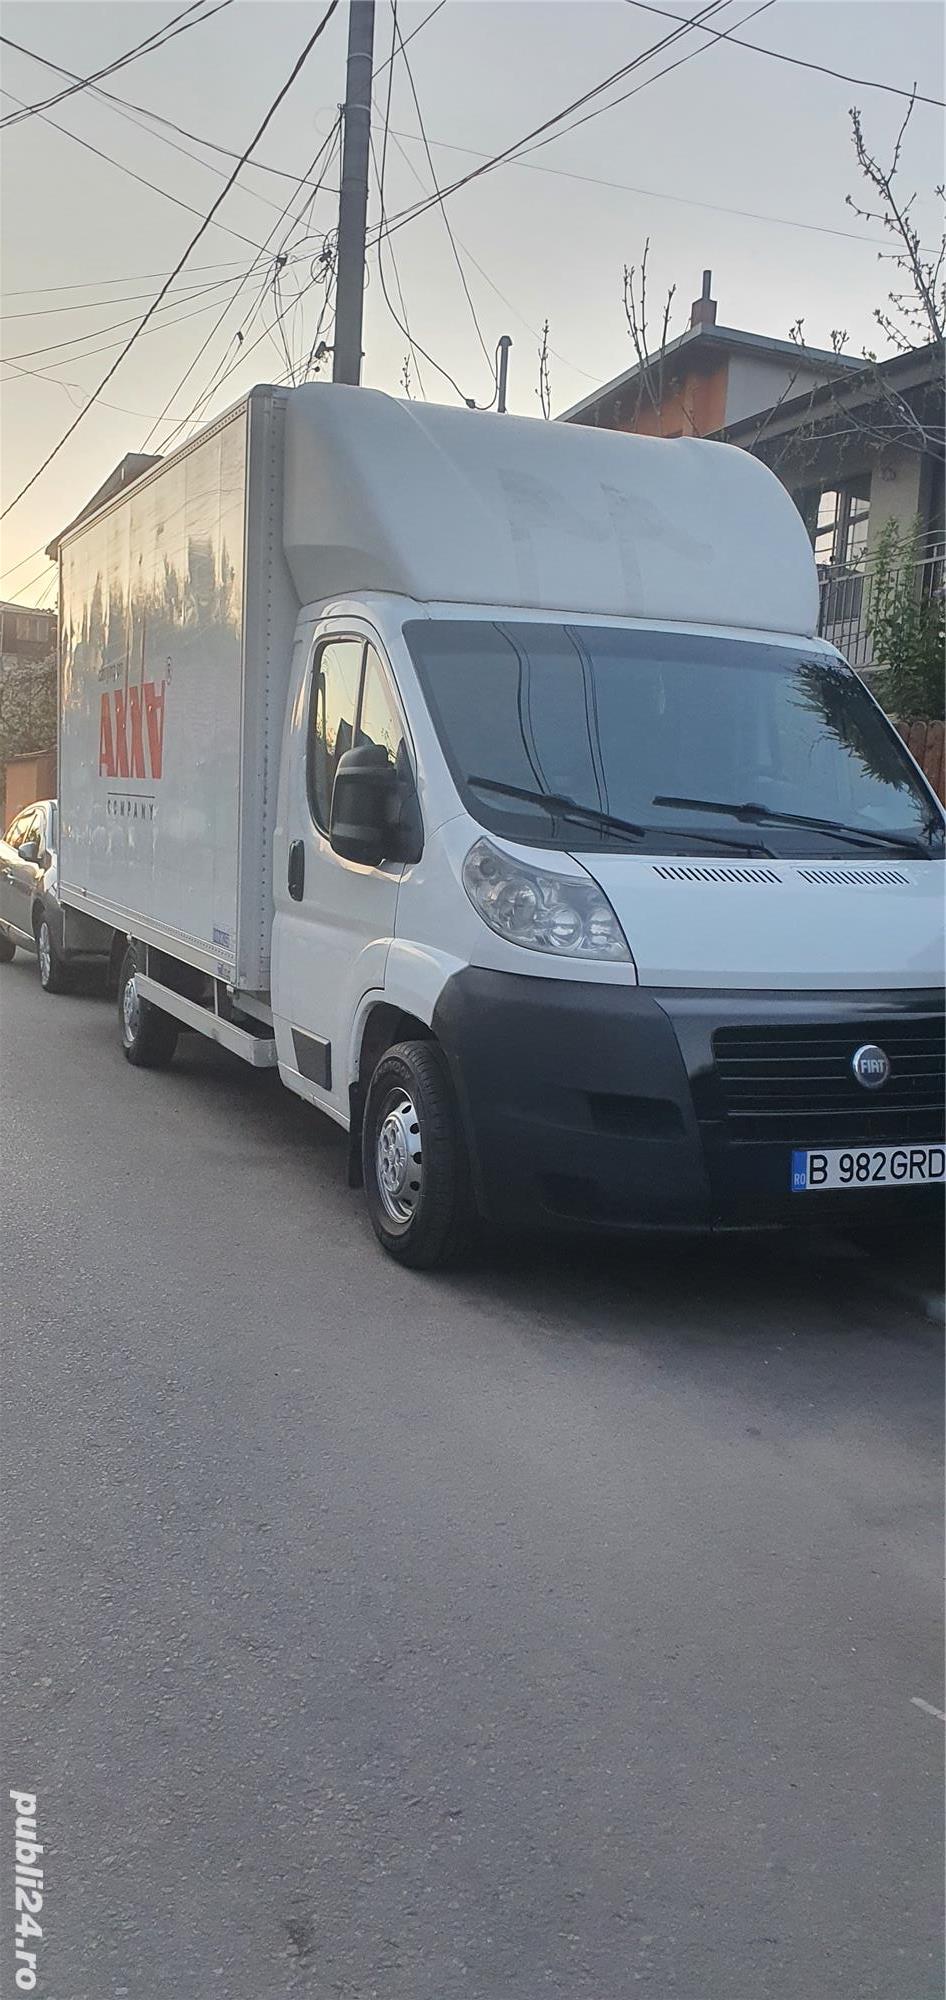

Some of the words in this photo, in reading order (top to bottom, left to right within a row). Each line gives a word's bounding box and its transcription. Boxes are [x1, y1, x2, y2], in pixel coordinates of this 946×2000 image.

[107, 799, 154, 820] COMPANY
[860, 1059, 885, 1073] FIAT
[809, 1154, 828, 1185] B
[793, 1173, 806, 1185] RO
